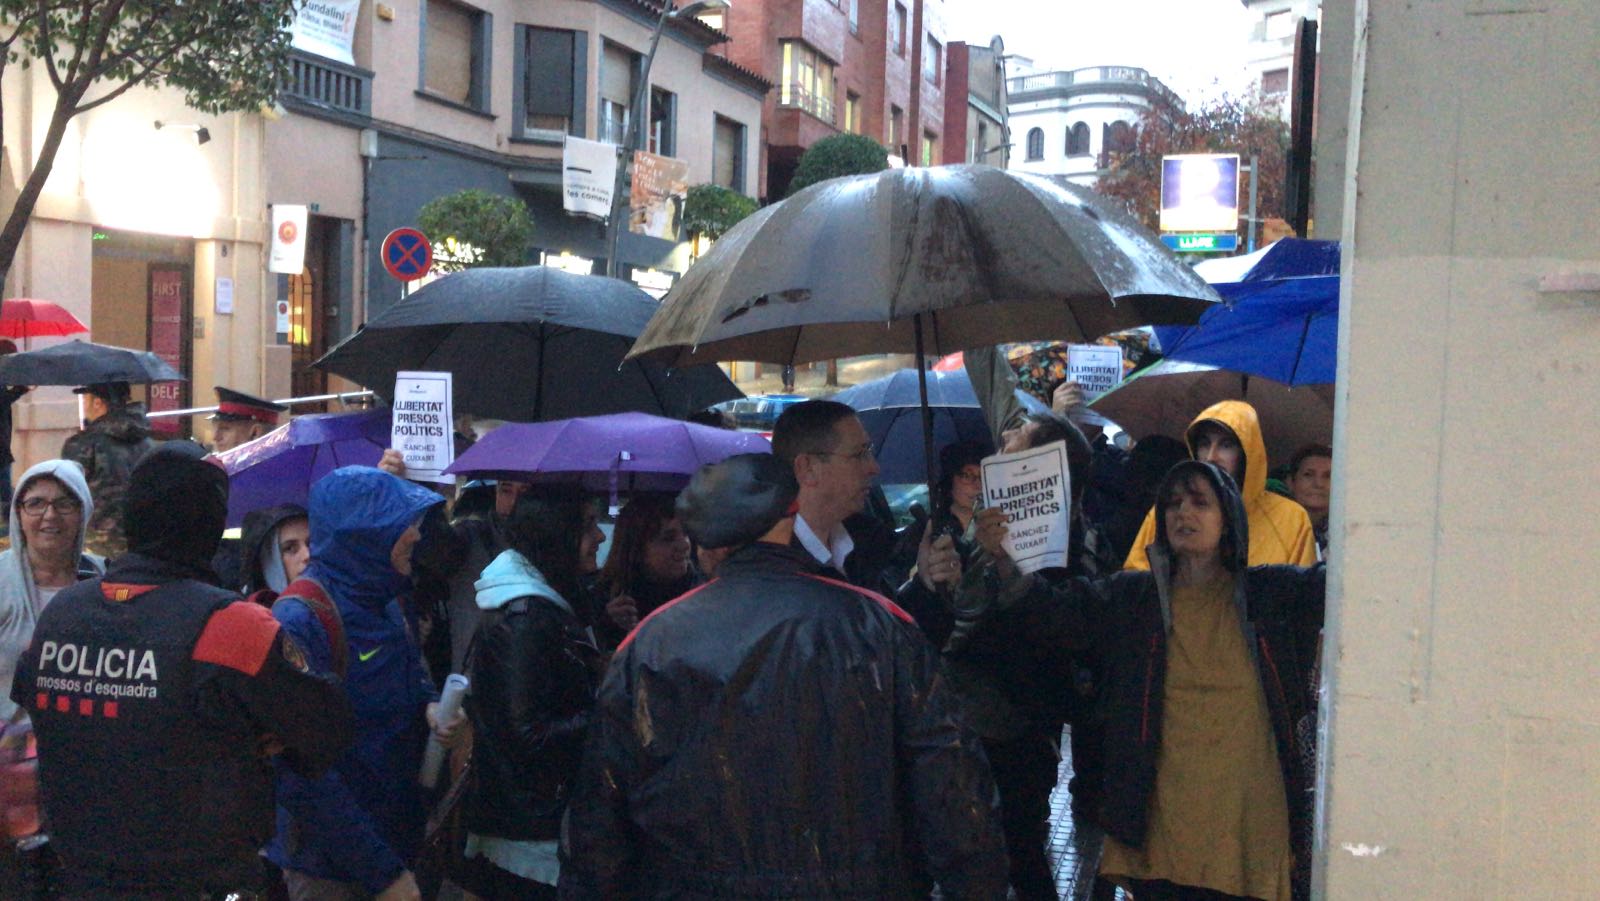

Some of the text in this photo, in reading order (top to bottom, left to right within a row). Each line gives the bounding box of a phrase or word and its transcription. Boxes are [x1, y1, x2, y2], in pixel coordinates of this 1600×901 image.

[152, 282, 181, 297] FIRST
[1071, 365, 1117, 375] LLIBERTAT
[1076, 374, 1112, 383] PRESOS
[151, 385, 180, 400] DELF
[395, 400, 444, 413] LLIBERTAT
[398, 413, 439, 424] PRESOS
[406, 454, 435, 462] CUIXART
[990, 473, 1060, 501] LLIBERTAT
[1000, 489, 1055, 513] PRESOS
[1007, 501, 1060, 524] OLÍTICS
[1014, 536, 1048, 552] CUIXART
[38, 641, 158, 681] POLICIA
[36, 675, 157, 699] mossos d'esquadra
